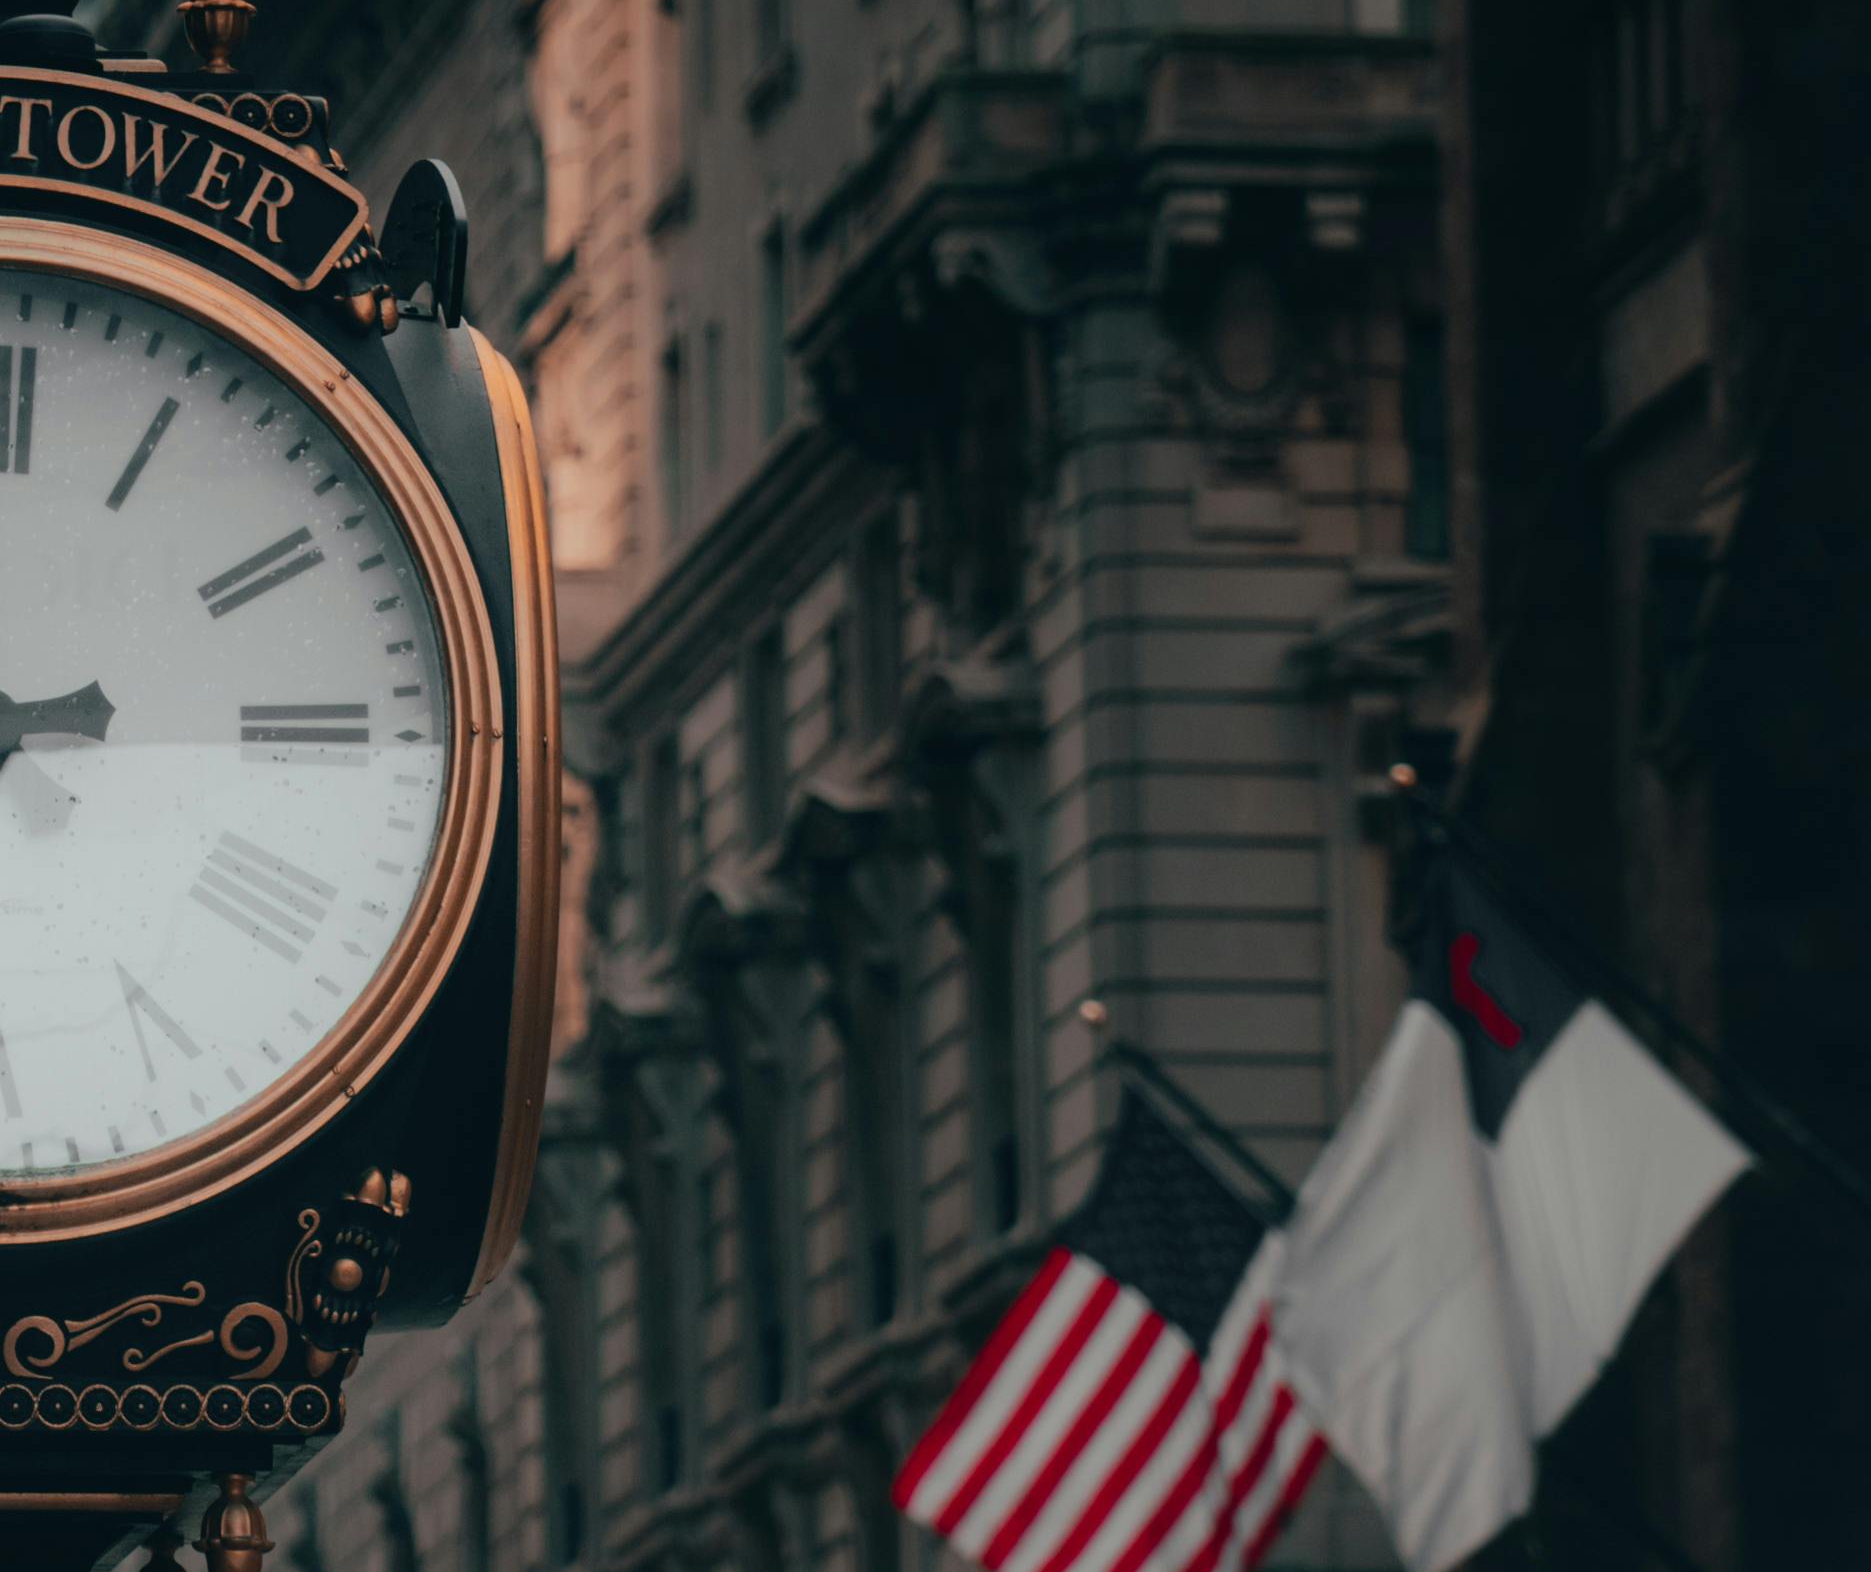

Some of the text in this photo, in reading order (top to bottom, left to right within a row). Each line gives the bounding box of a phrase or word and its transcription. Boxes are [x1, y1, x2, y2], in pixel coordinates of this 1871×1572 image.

[105, 396, 180, 513] I
[197, 525, 325, 620] II
[239, 703, 370, 768] III
[188, 828, 340, 966] IIII
[113, 957, 204, 1083] V
